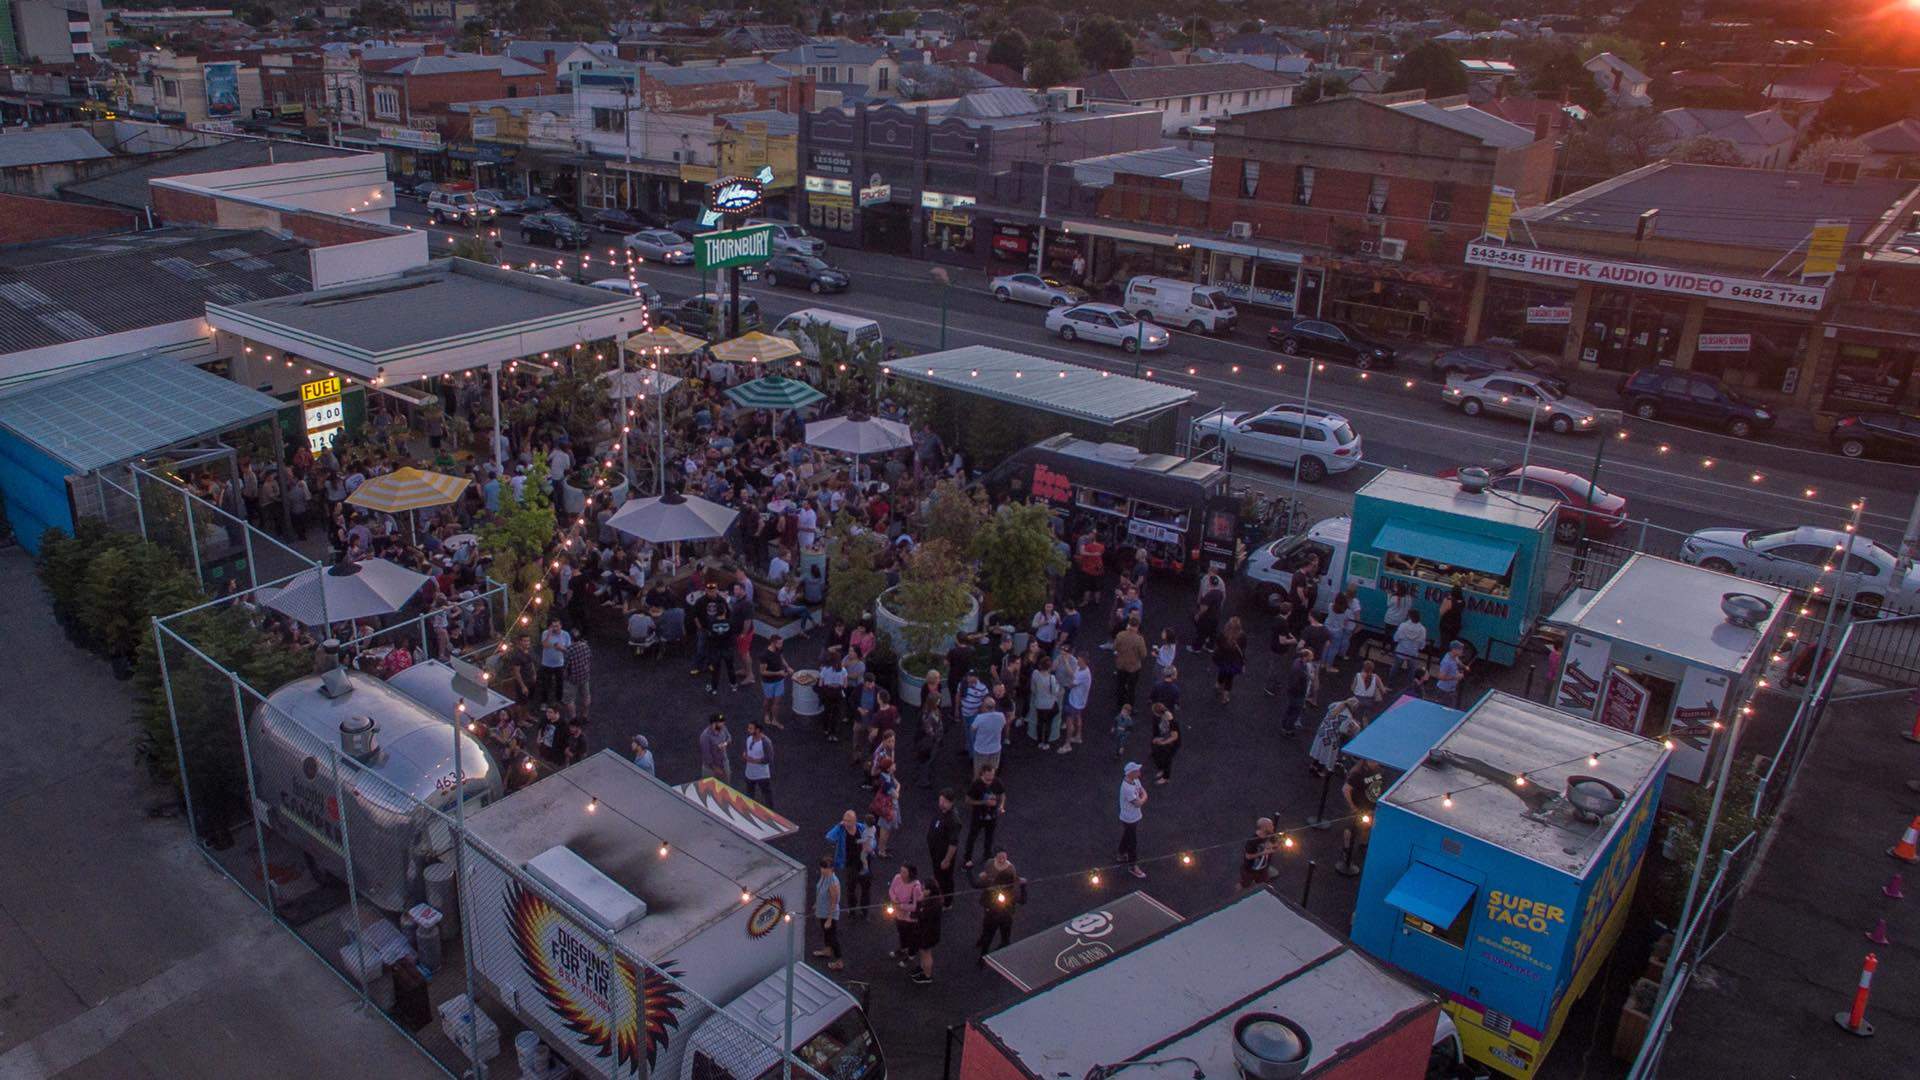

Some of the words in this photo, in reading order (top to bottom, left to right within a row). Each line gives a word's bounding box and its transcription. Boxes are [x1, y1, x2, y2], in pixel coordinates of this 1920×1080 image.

[705, 230, 770, 266] THORNBURY
[1471, 247, 1526, 263] 543-545
[1531, 255, 1591, 277] HITEK
[1597, 266, 1658, 285] AUDIO
[1664, 273, 1725, 294] VIDEO
[1731, 286, 1773, 300] 9482
[1779, 292, 1818, 305] 1744
[304, 379, 339, 399] FUEL
[1487, 903, 1547, 932] TACO
[1488, 890, 1565, 923] SUPER
[558, 926, 610, 980] DIGGING
[551, 940, 580, 978] FOR
[585, 965, 613, 1003] FIR
